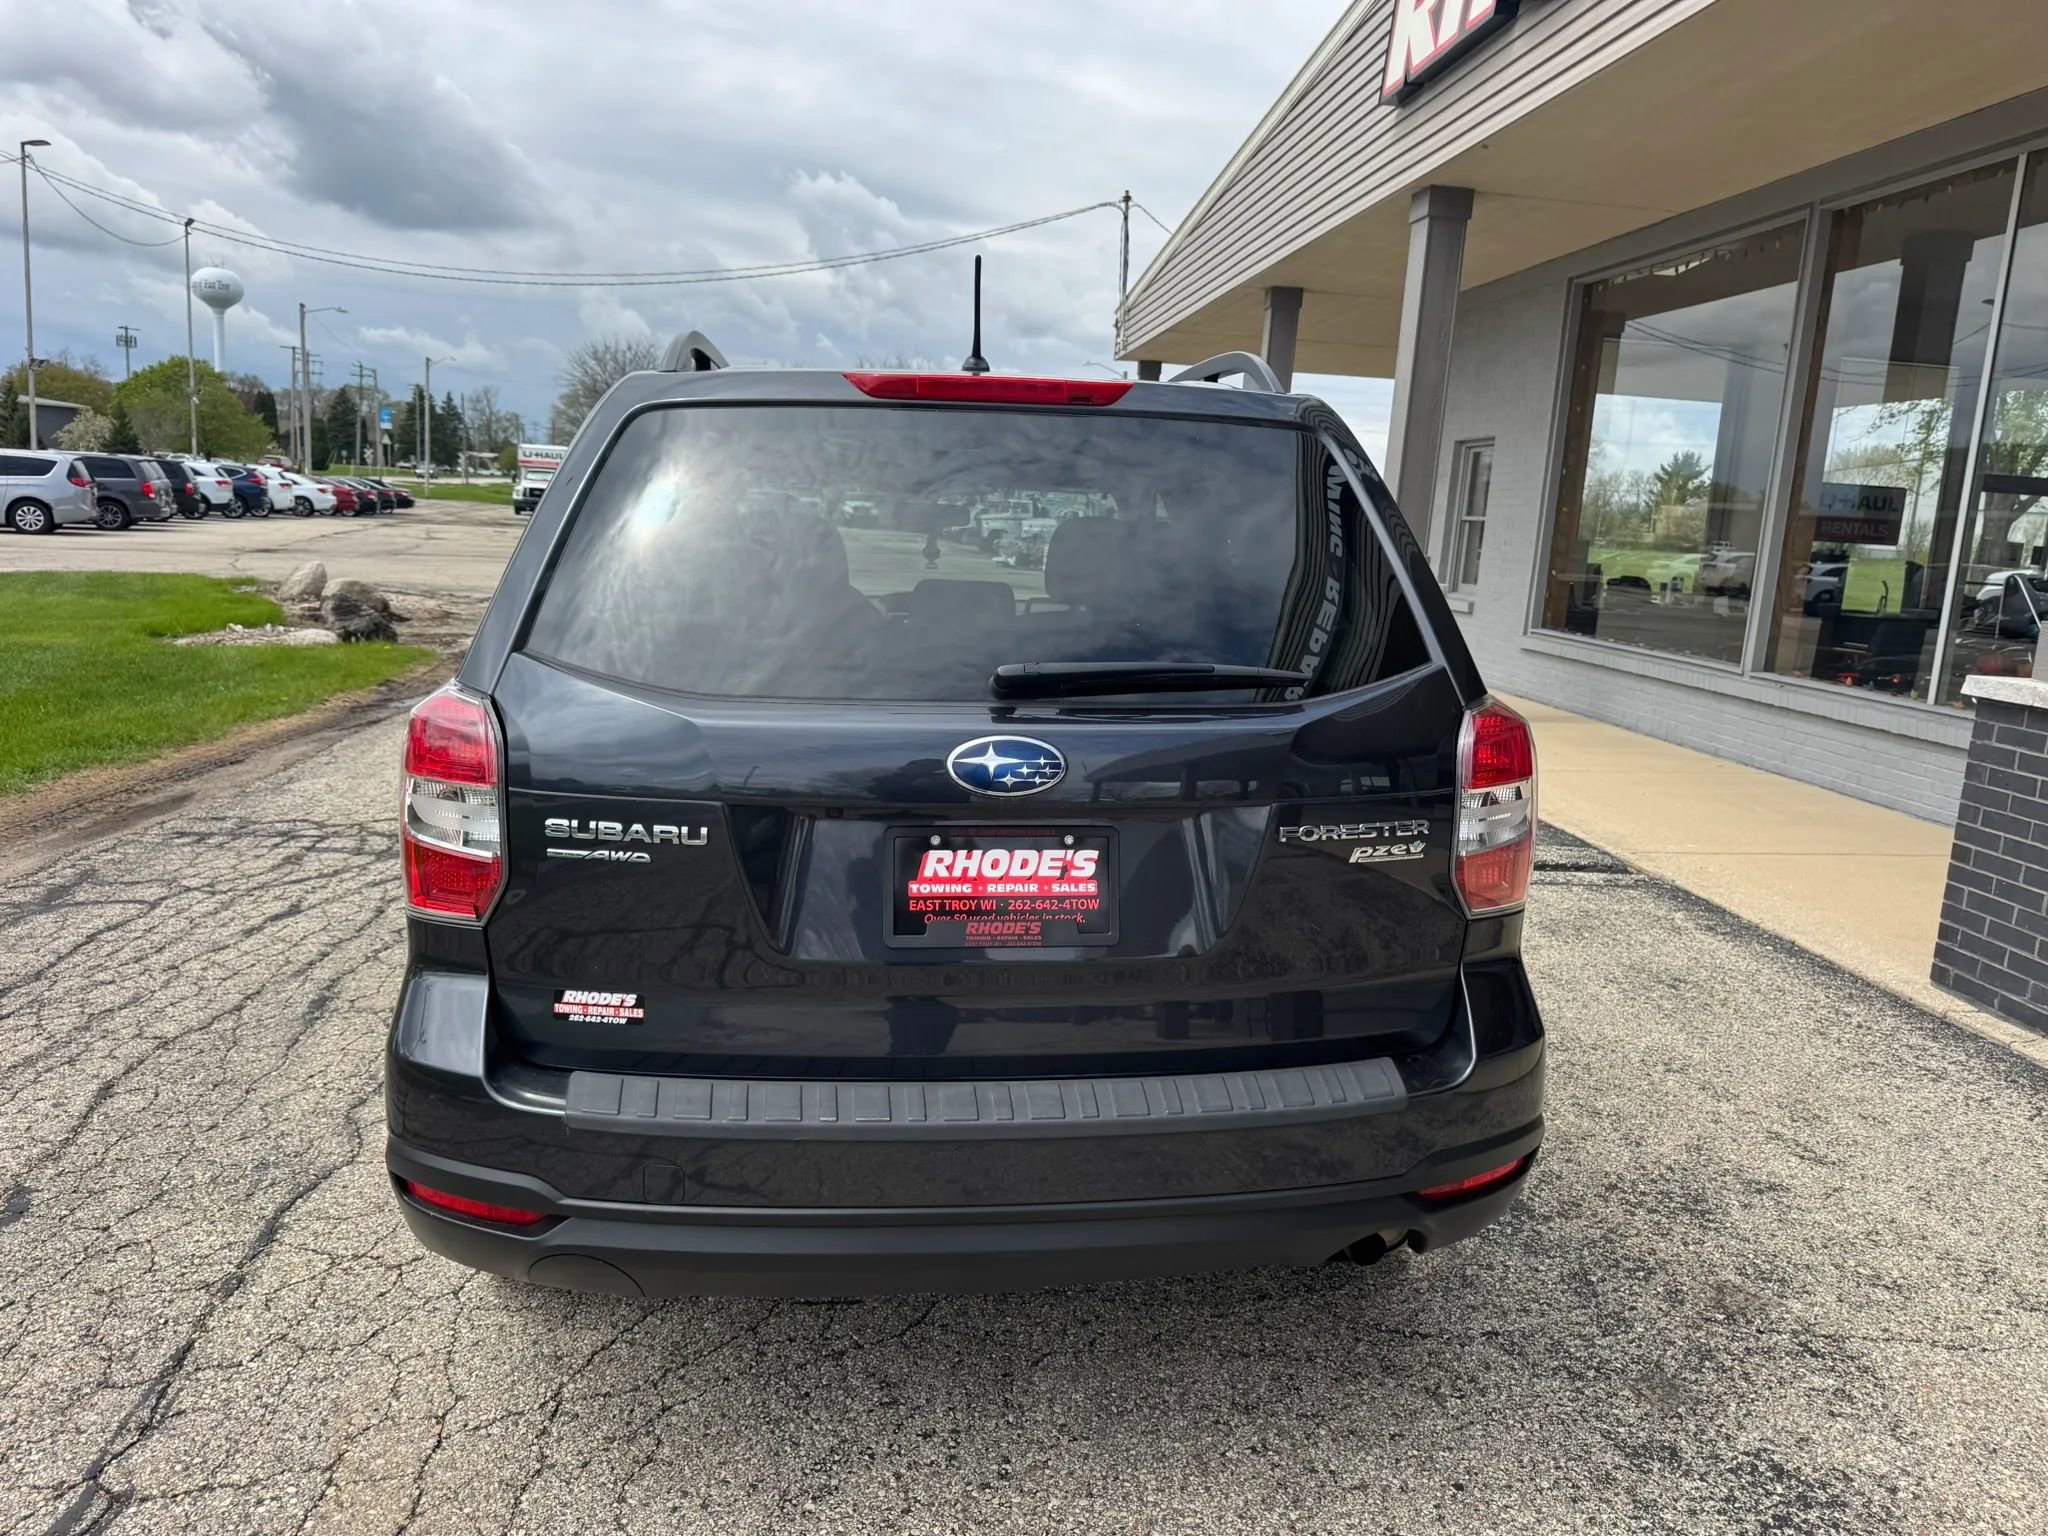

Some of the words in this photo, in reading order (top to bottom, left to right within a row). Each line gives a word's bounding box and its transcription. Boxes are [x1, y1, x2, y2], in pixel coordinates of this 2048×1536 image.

[1822, 520, 1889, 537] RENTALS
[544, 818, 708, 846] SUBARU
[1279, 819, 1430, 843] FORESTER
[584, 850, 652, 863] AWD
[918, 849, 1099, 879] RHODE'S
[910, 883, 973, 894] TOWING
[986, 883, 1039, 893] REPAIR
[1051, 883, 1096, 893] SALES
[909, 899, 939, 911] EAST
[944, 899, 977, 910] TROY
[980, 899, 997, 910] WI
[1008, 898, 1099, 910] 262-642-4TOW
[965, 921, 1042, 934] RHODE'S
[561, 990, 637, 1007] RHODE'S
[554, 1003, 583, 1014] TOWING
[588, 1006, 615, 1016] REPAIR
[619, 1008, 644, 1018] SALES
